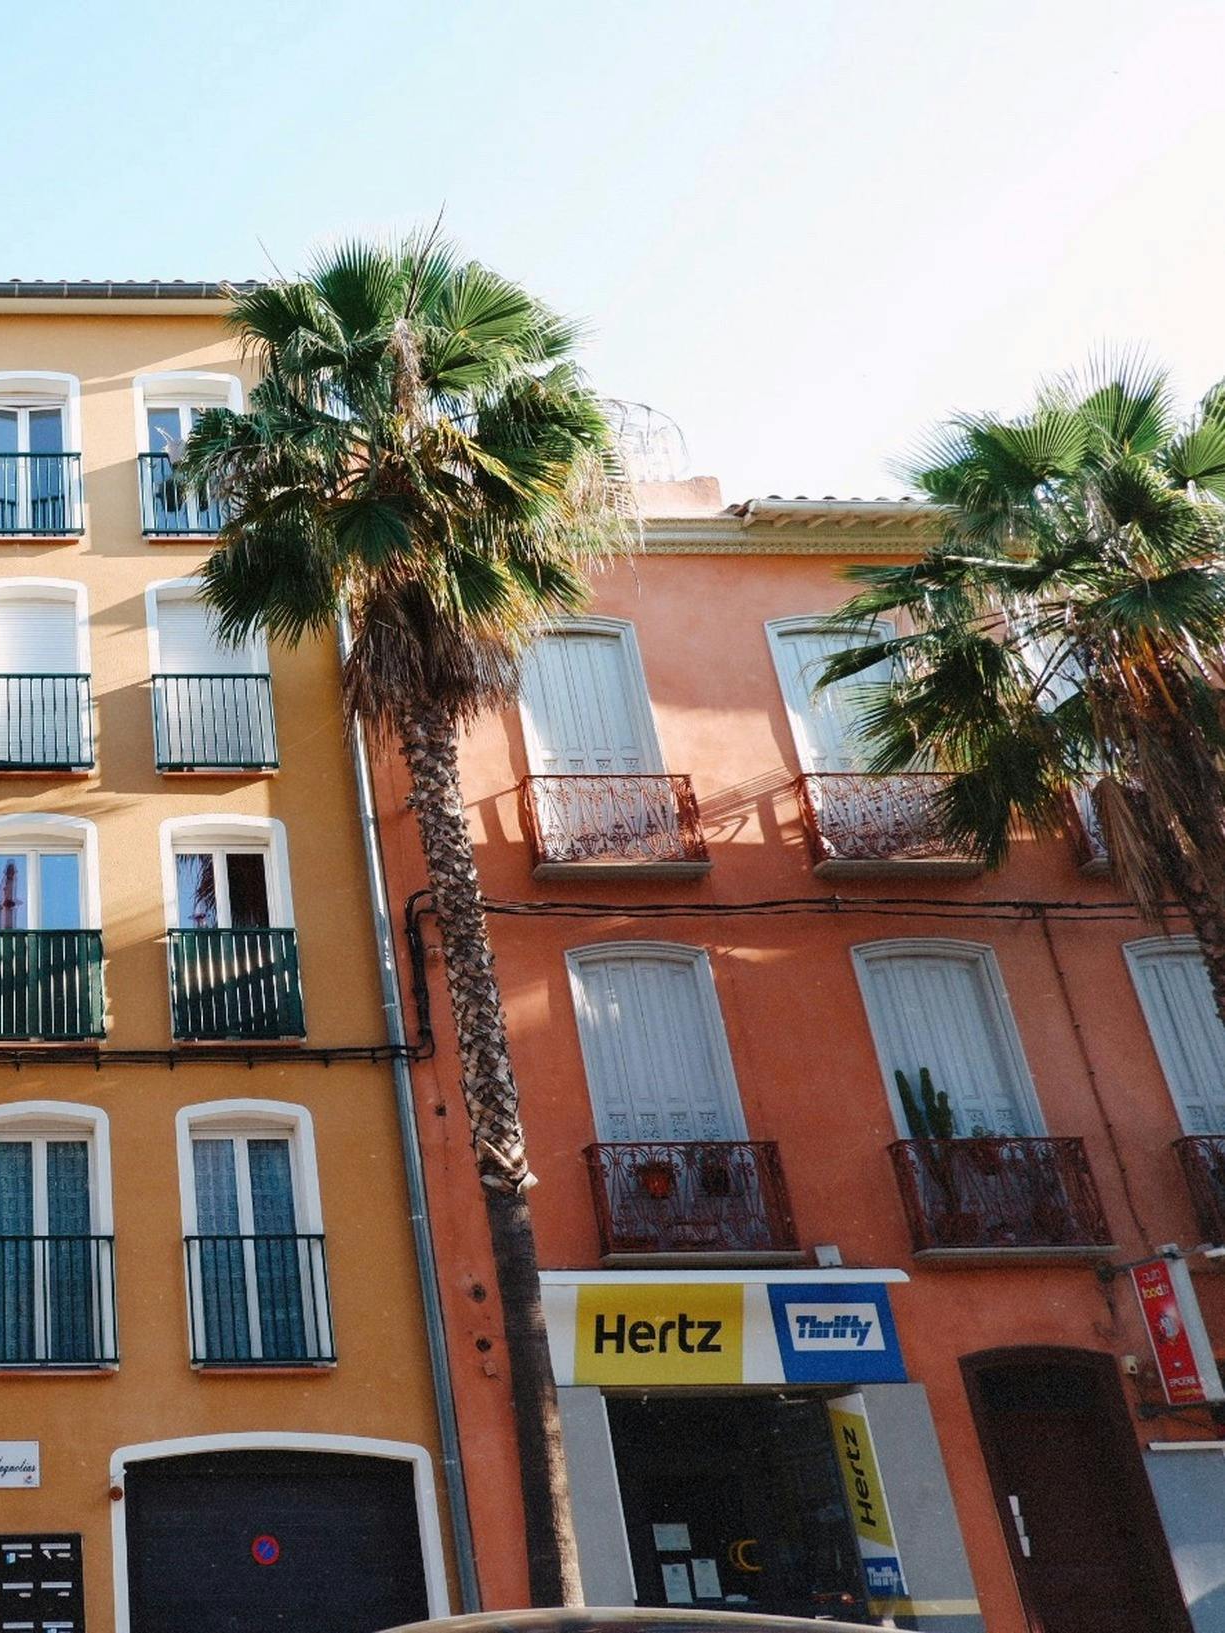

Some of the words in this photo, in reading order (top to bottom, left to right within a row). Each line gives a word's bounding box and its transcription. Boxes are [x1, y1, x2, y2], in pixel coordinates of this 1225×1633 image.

[594, 1313, 722, 1354] Hertz
[795, 1314, 873, 1346] Thrifty
[842, 1425, 877, 1527] Hertz
